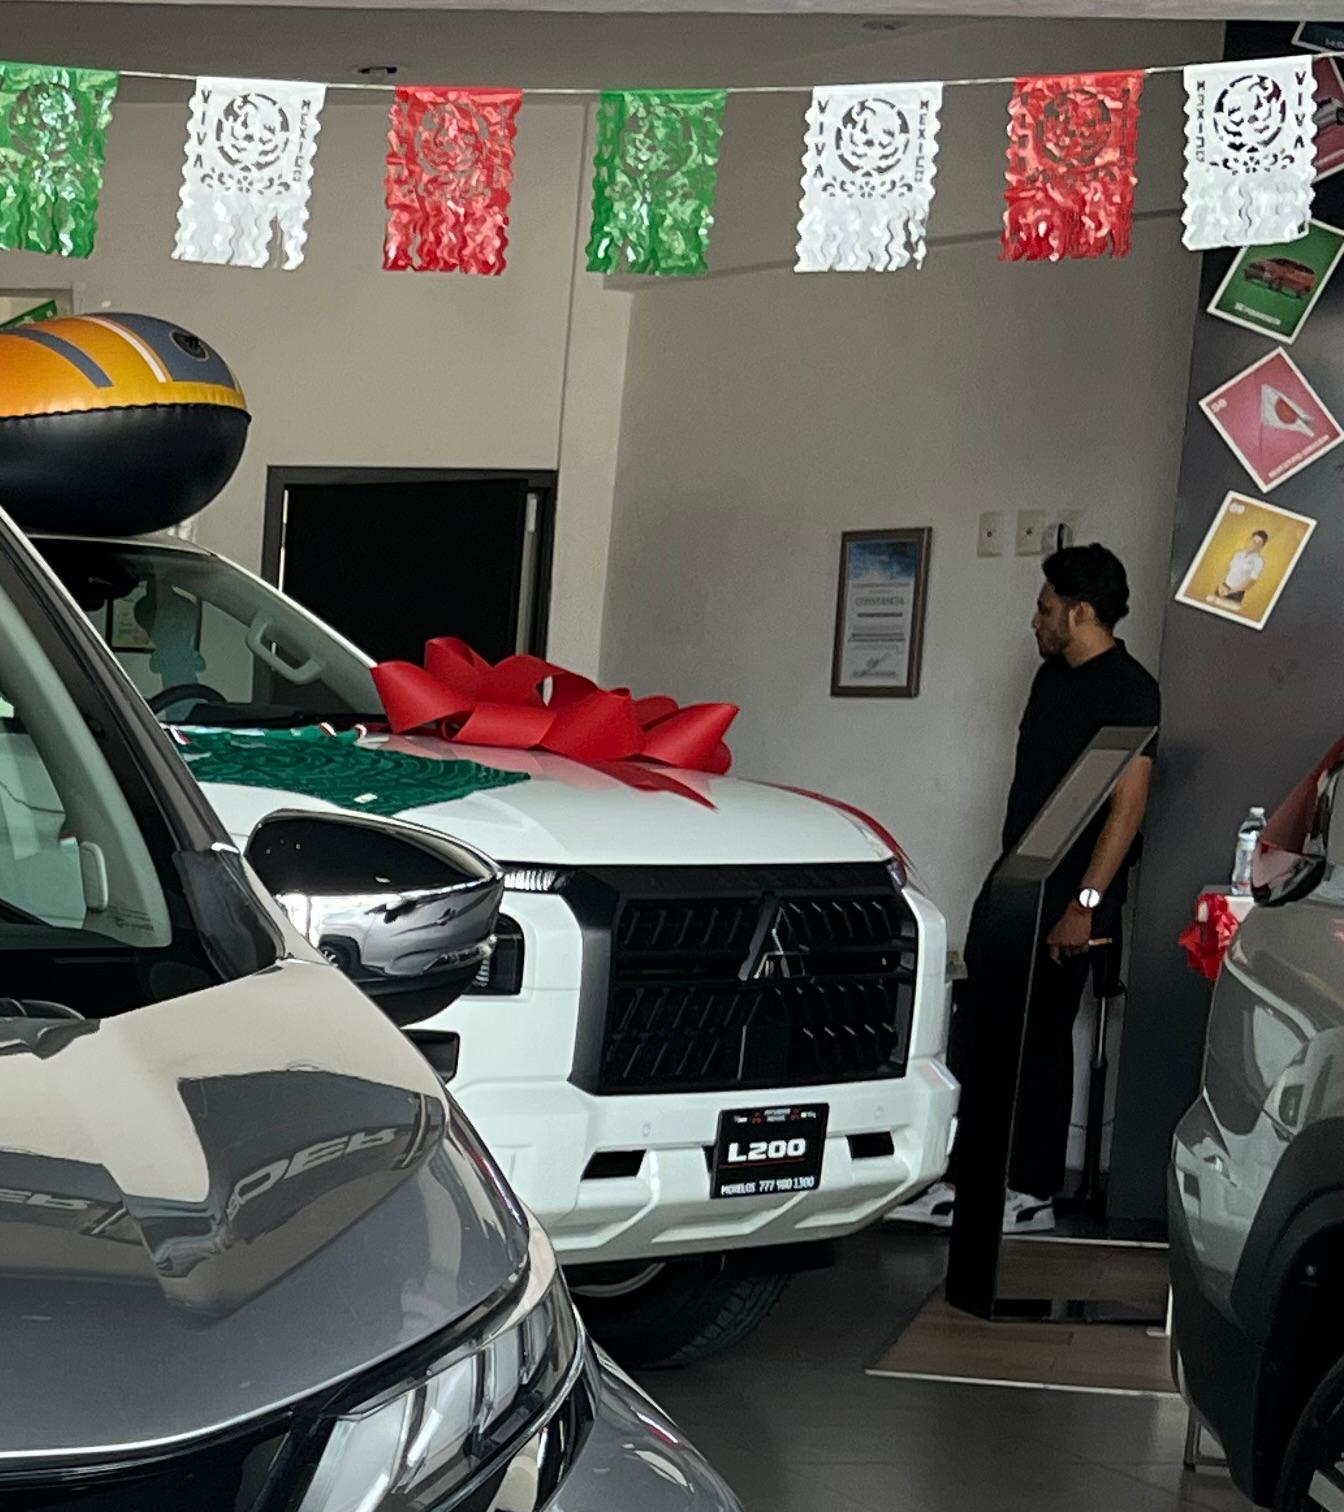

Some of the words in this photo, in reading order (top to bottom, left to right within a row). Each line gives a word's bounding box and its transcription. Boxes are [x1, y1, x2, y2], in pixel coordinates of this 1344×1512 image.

[193, 89, 212, 168] VIVA
[292, 99, 311, 182] MEXICO
[813, 99, 830, 179] VIVA
[914, 99, 930, 183] MEXICO
[727, 1138, 806, 1163] L200
[758, 1179, 775, 1192] 777
[793, 1175, 815, 1189] 1300
